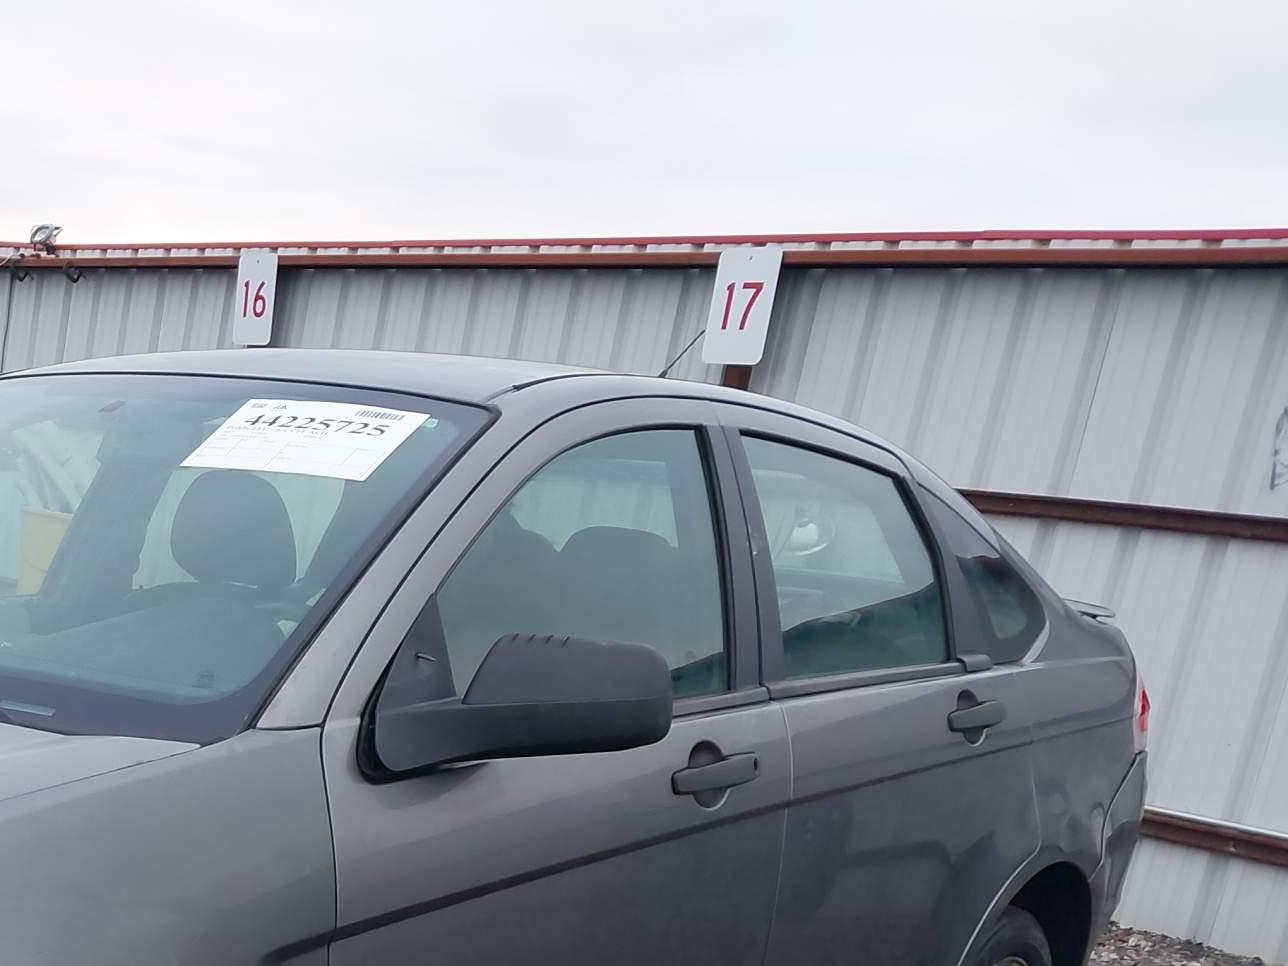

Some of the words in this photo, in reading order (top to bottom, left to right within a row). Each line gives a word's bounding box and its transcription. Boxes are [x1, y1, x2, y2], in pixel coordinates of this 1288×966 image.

[243, 279, 266, 318] 16
[721, 282, 765, 331] 17
[244, 413, 391, 437] 44225725
